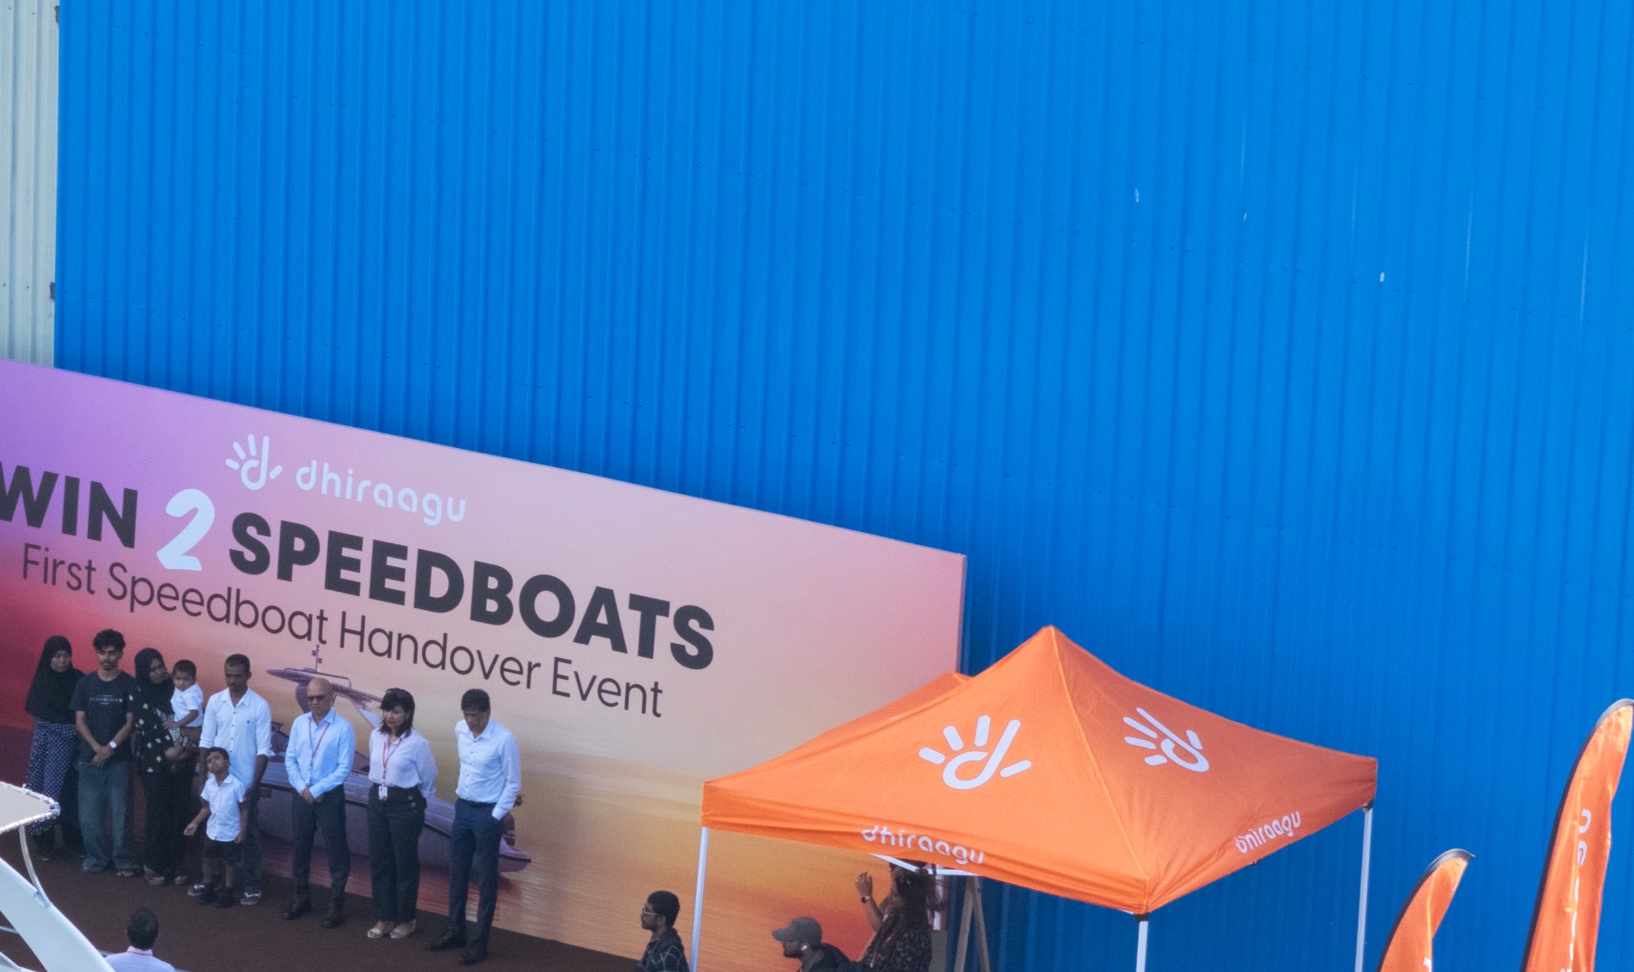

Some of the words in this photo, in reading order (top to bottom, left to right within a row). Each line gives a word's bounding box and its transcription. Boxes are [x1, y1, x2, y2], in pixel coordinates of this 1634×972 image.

[295, 460, 466, 526] dhiraagu
[156, 488, 215, 571] 2
[229, 512, 715, 670] SPEEDBOATS
[23, 542, 96, 595] First
[107, 562, 328, 645] Speedboat
[340, 610, 541, 689] Handover
[552, 656, 663, 717] Event
[861, 824, 985, 865] dhiraagu
[1234, 810, 1301, 854] dhiraagu
